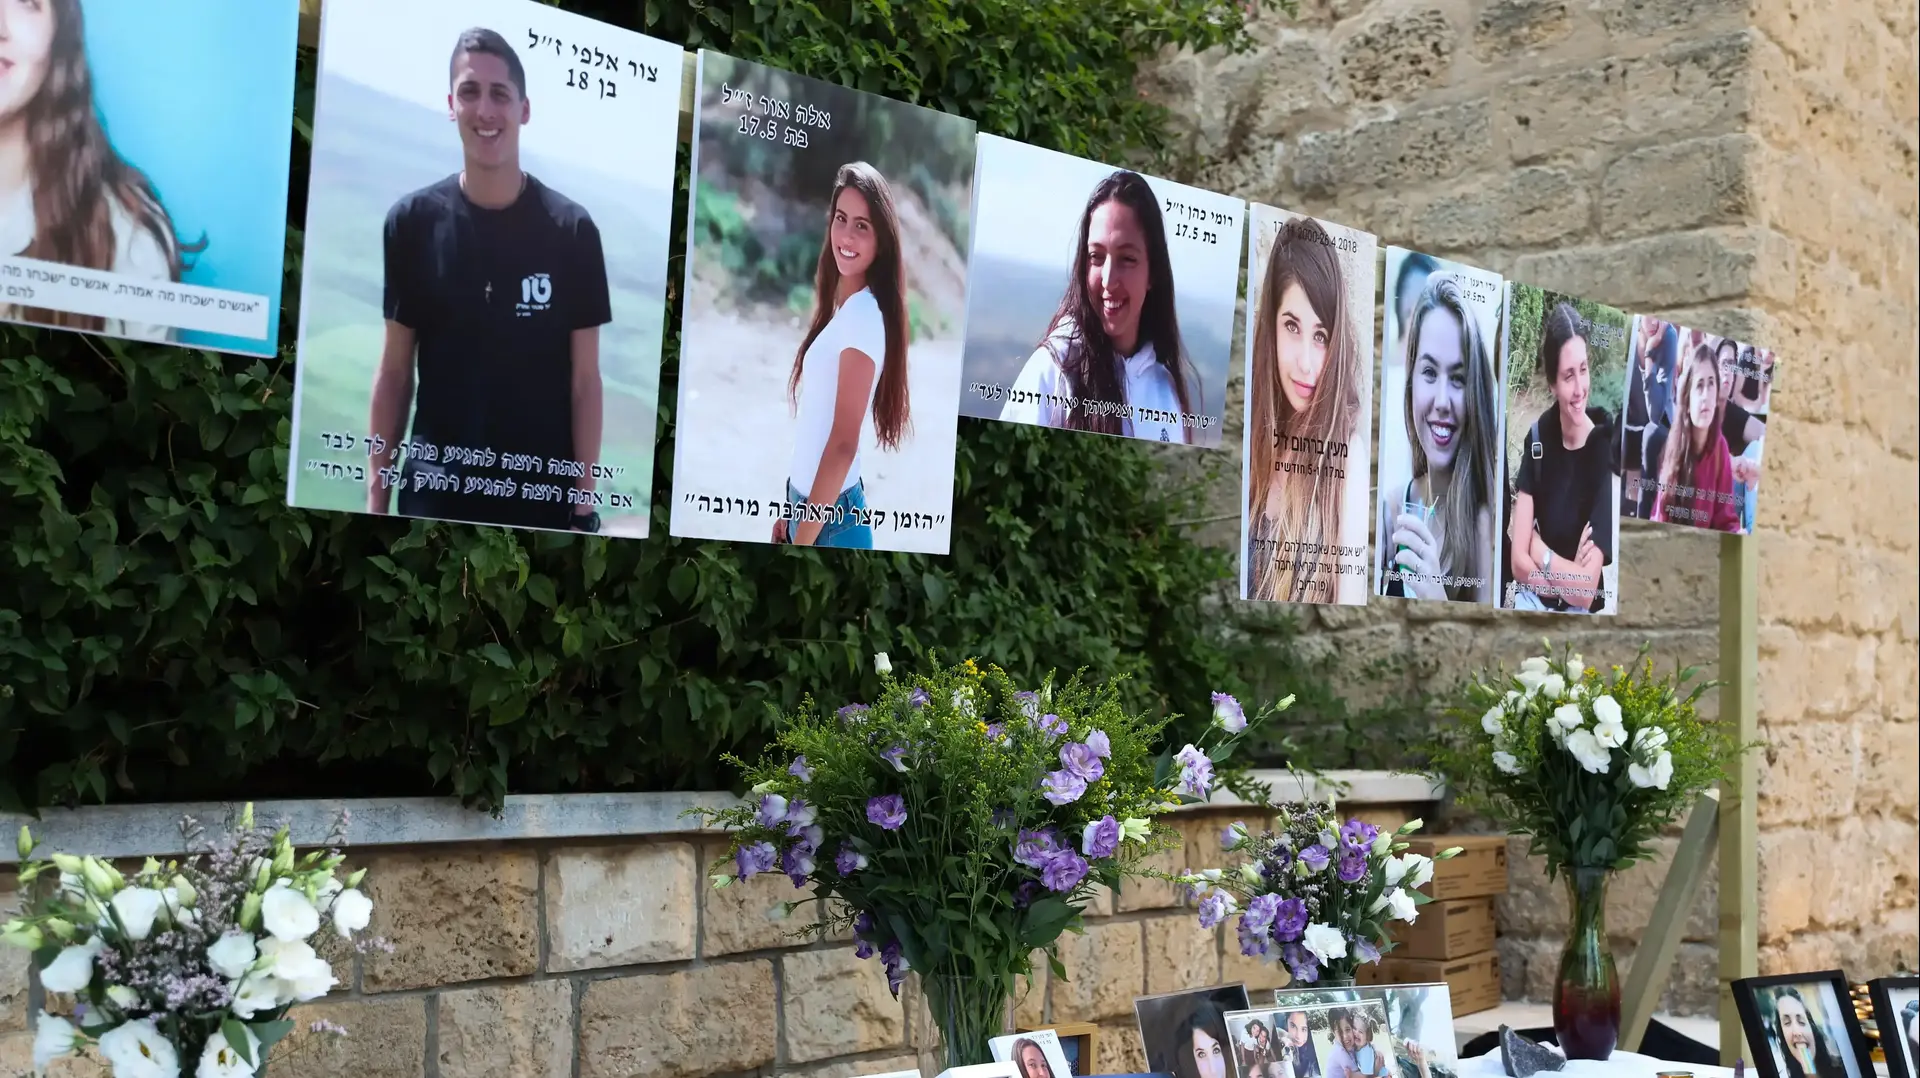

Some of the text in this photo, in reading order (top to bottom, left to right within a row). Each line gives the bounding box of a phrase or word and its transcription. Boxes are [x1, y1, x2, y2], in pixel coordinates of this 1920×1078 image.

[572, 44, 618, 73] אלפי
[628, 60, 658, 82] צור
[566, 68, 617, 100] בן 18
[759, 95, 789, 120] אור
[796, 104, 830, 130] אלה
[738, 114, 808, 148] בת 17.5
[1188, 206, 1207, 221] כהן
[1210, 211, 1233, 227] רומי
[1175, 223, 1217, 245] בת 17.5
[158, 289, 176, 302] מה
[1006, 387, 1042, 405] דרכנו
[1046, 393, 1079, 410] יאירו
[1082, 398, 1134, 419] וצניעותך
[1138, 406, 1178, 424] אהבתך
[320, 431, 356, 451] לבד
[363, 433, 386, 458] לך
[1291, 436, 1325, 454] ברהום
[1326, 440, 1348, 459] מעין
[442, 445, 496, 468] להגיע
[501, 452, 543, 473] רוצה
[548, 457, 585, 478] אתה
[413, 471, 459, 492] רחוק
[463, 476, 517, 497] להגיע
[521, 482, 562, 502] רוצה
[567, 487, 603, 506] אתה
[610, 493, 633, 508] אם
[768, 500, 844, 524] והאהבה
[851, 506, 886, 531] קצר
